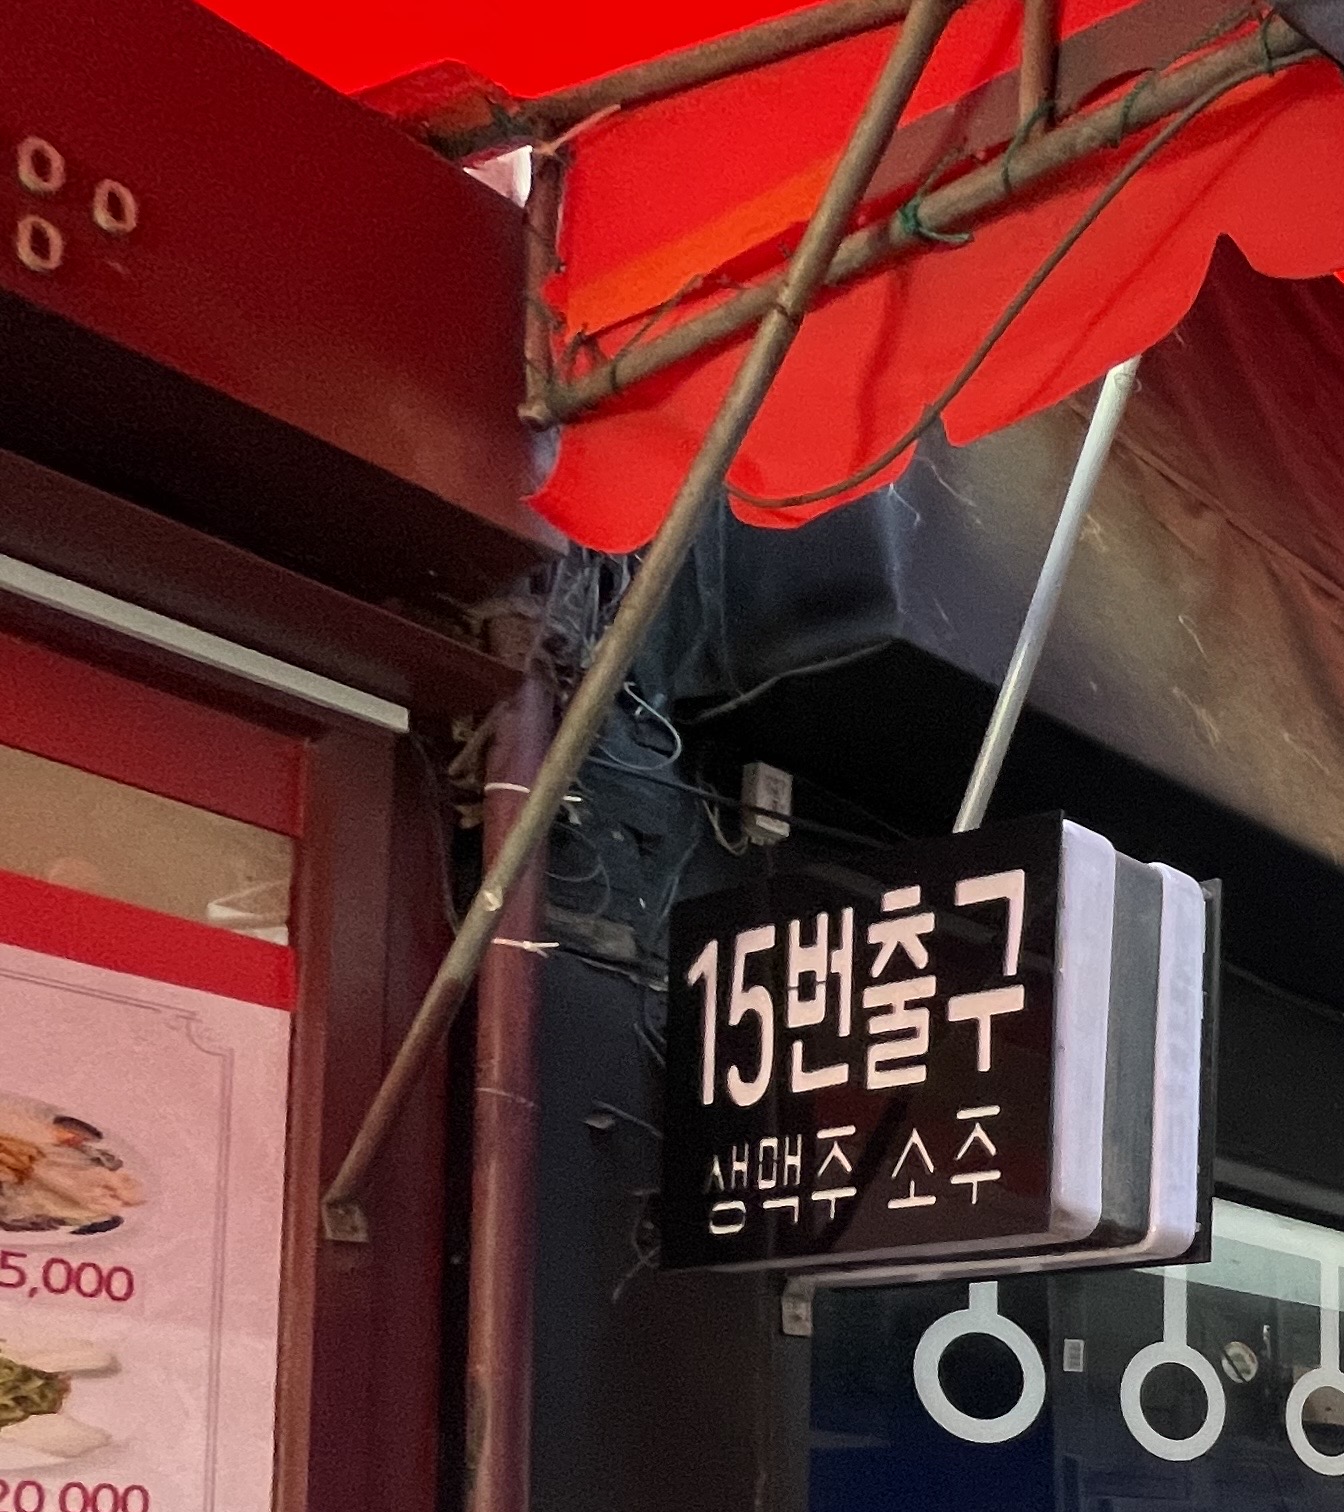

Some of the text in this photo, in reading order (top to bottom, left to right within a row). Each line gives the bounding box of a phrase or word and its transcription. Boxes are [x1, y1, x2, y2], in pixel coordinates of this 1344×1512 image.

[686, 868, 1025, 1108] 15번출구
[708, 1104, 1002, 1236] 생맥주 소주
